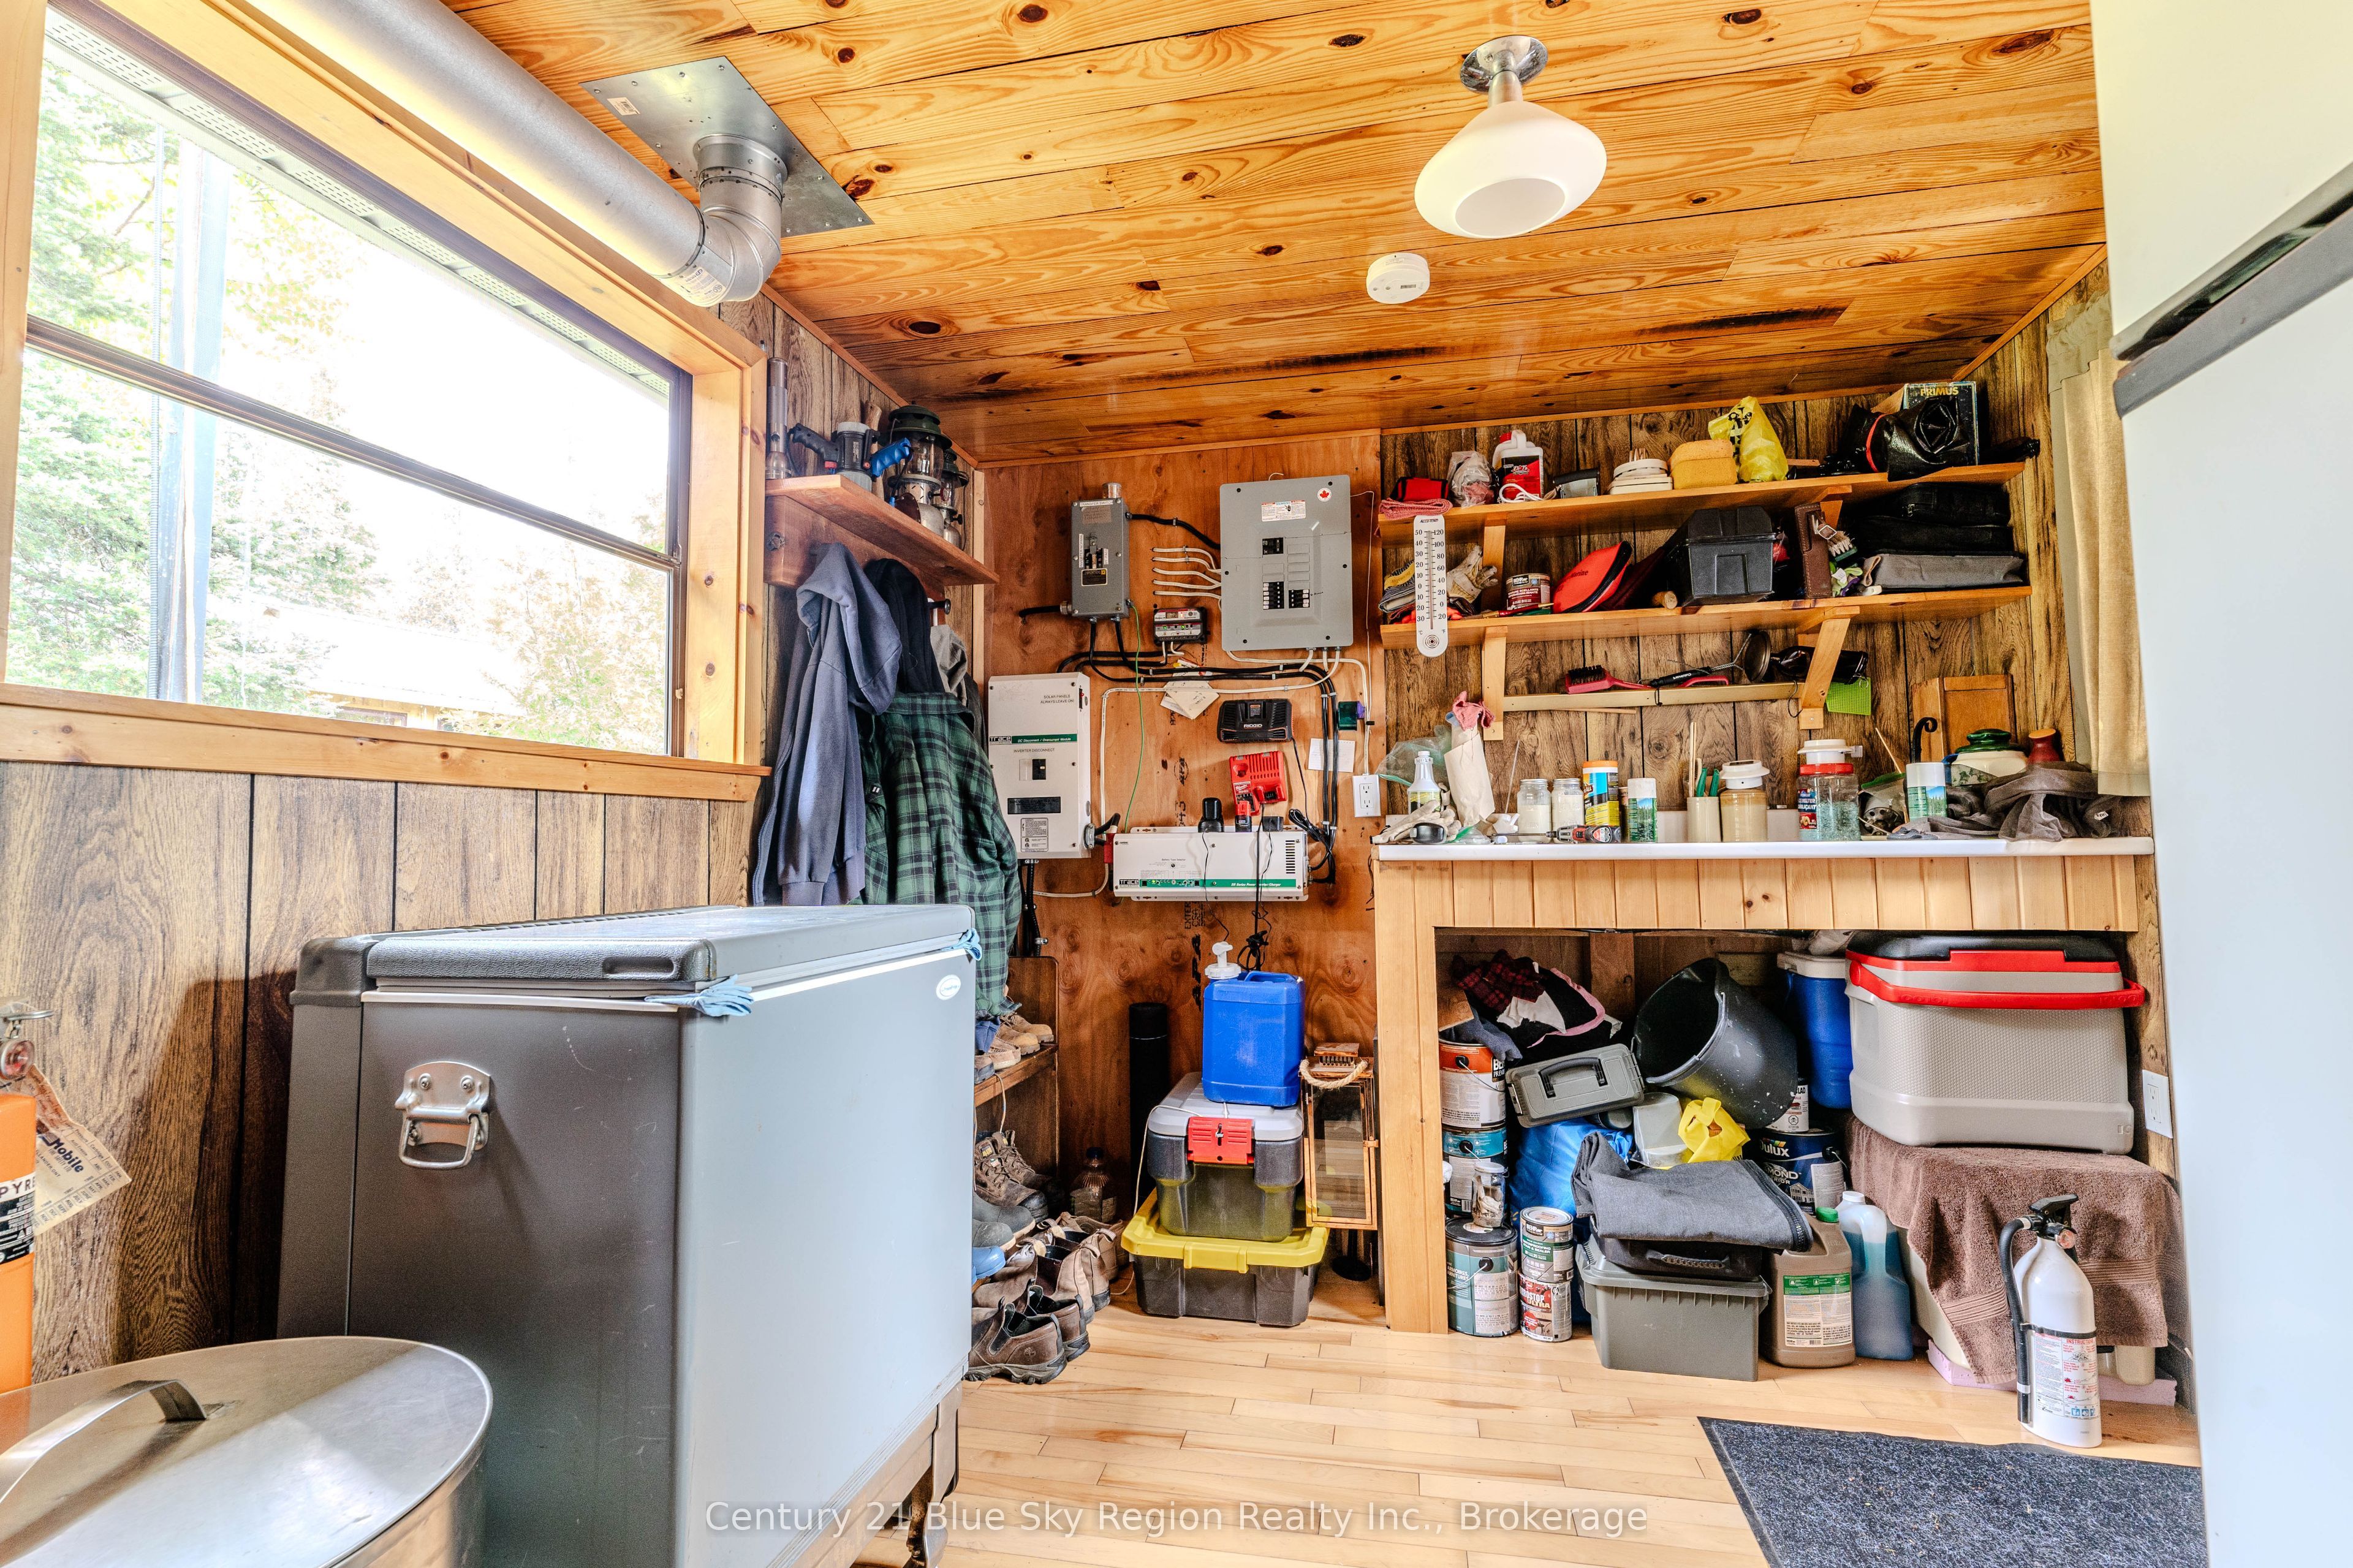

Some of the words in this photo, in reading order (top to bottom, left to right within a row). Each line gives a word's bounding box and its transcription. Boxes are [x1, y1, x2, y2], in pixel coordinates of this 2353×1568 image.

[1920, 387, 1959, 396] PRIMUS
[75, 1129, 88, 1143] Pressure
[90, 1144, 104, 1159] Cartridge
[1759, 1141, 1790, 1157] Dulux
[53, 1137, 85, 1173] Mobile
[1447, 1271, 1469, 1281] ARNITURES
[1528, 1299, 1550, 1309] ULTRA
